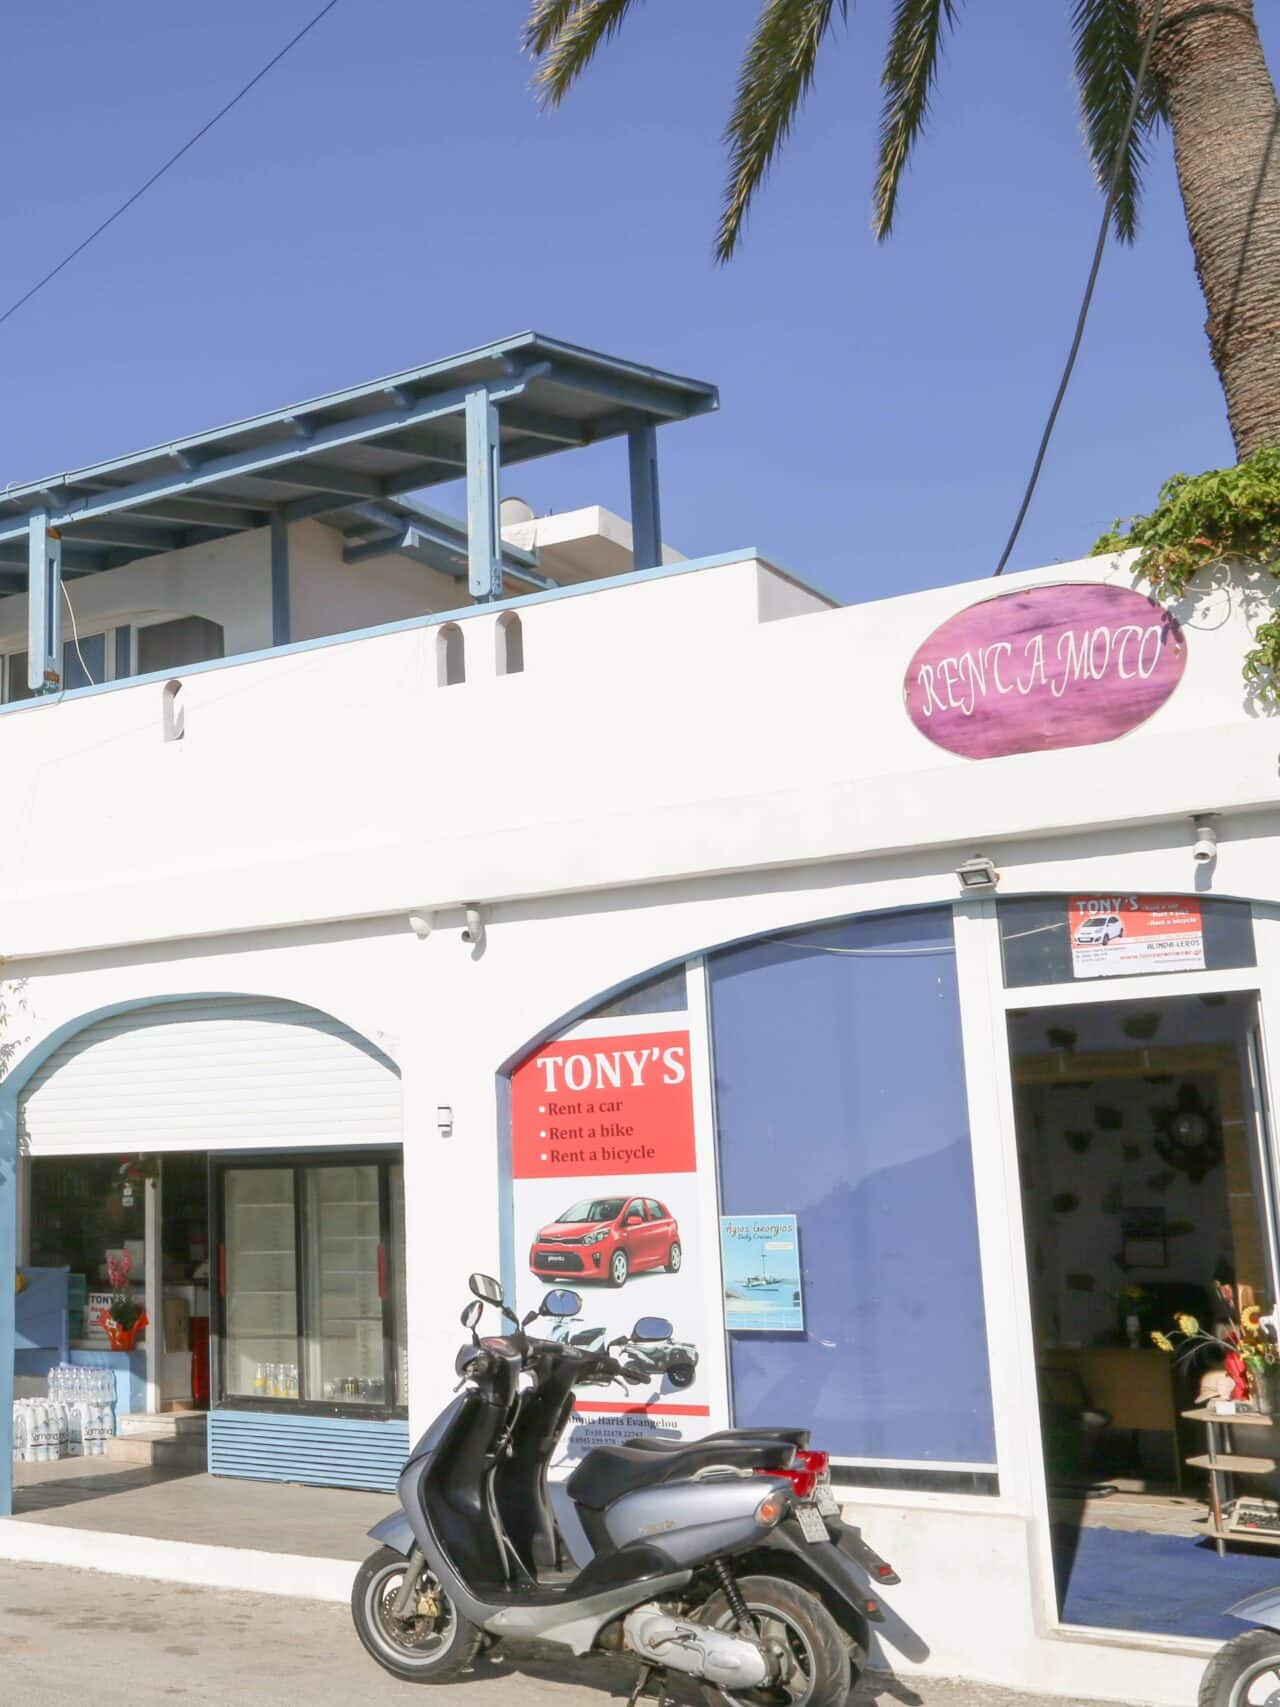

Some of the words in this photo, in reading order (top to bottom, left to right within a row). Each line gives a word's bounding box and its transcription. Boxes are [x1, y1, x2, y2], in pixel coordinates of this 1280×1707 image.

[1017, 634, 1049, 694] A
[1076, 895, 1139, 915] TONY'S
[536, 1046, 686, 1093] TONY'S
[548, 1102, 582, 1116] Rent
[586, 1103, 595, 1114] a
[599, 1100, 624, 1113] car
[549, 1126, 584, 1140] Rent
[587, 1127, 597, 1138] a
[600, 1123, 634, 1138] bike
[550, 1149, 586, 1163] Rent
[588, 1151, 598, 1161] a
[601, 1145, 656, 1163] bicycle
[598, 1415, 625, 1426] Haris
[626, 1416, 679, 1430] Evangelou
